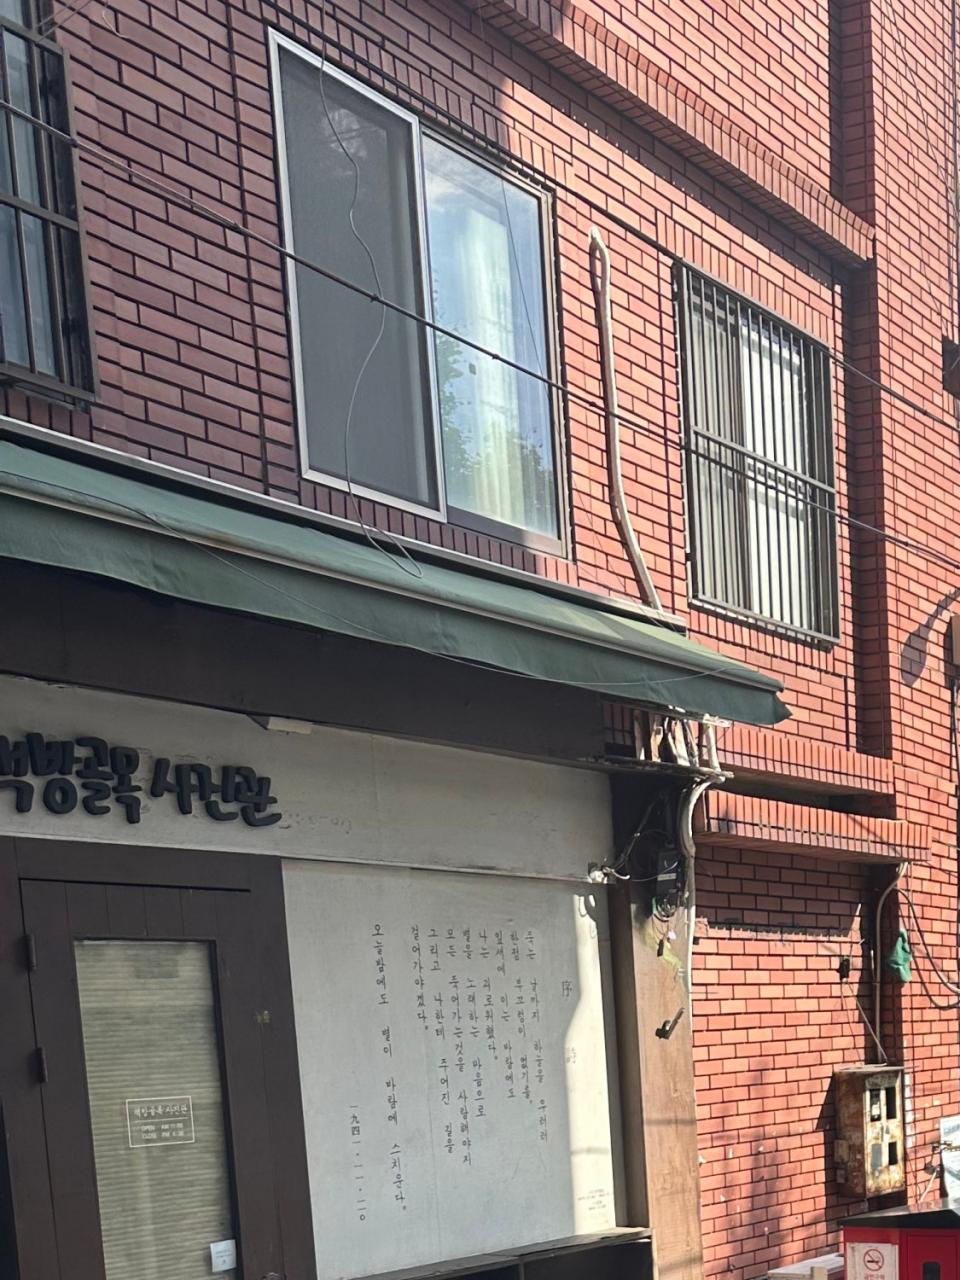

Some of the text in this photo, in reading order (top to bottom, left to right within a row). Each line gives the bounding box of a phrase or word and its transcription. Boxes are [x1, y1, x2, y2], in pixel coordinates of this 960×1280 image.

[151, 757, 282, 827] 사진관
[427, 928, 442, 971] 그리고
[478, 928, 491, 958] 나는
[382, 1025, 393, 1058] 별이
[385, 1076, 398, 1126] 바람에
[438, 1058, 451, 1106] 주어진
[443, 1121, 455, 1154] 길을
